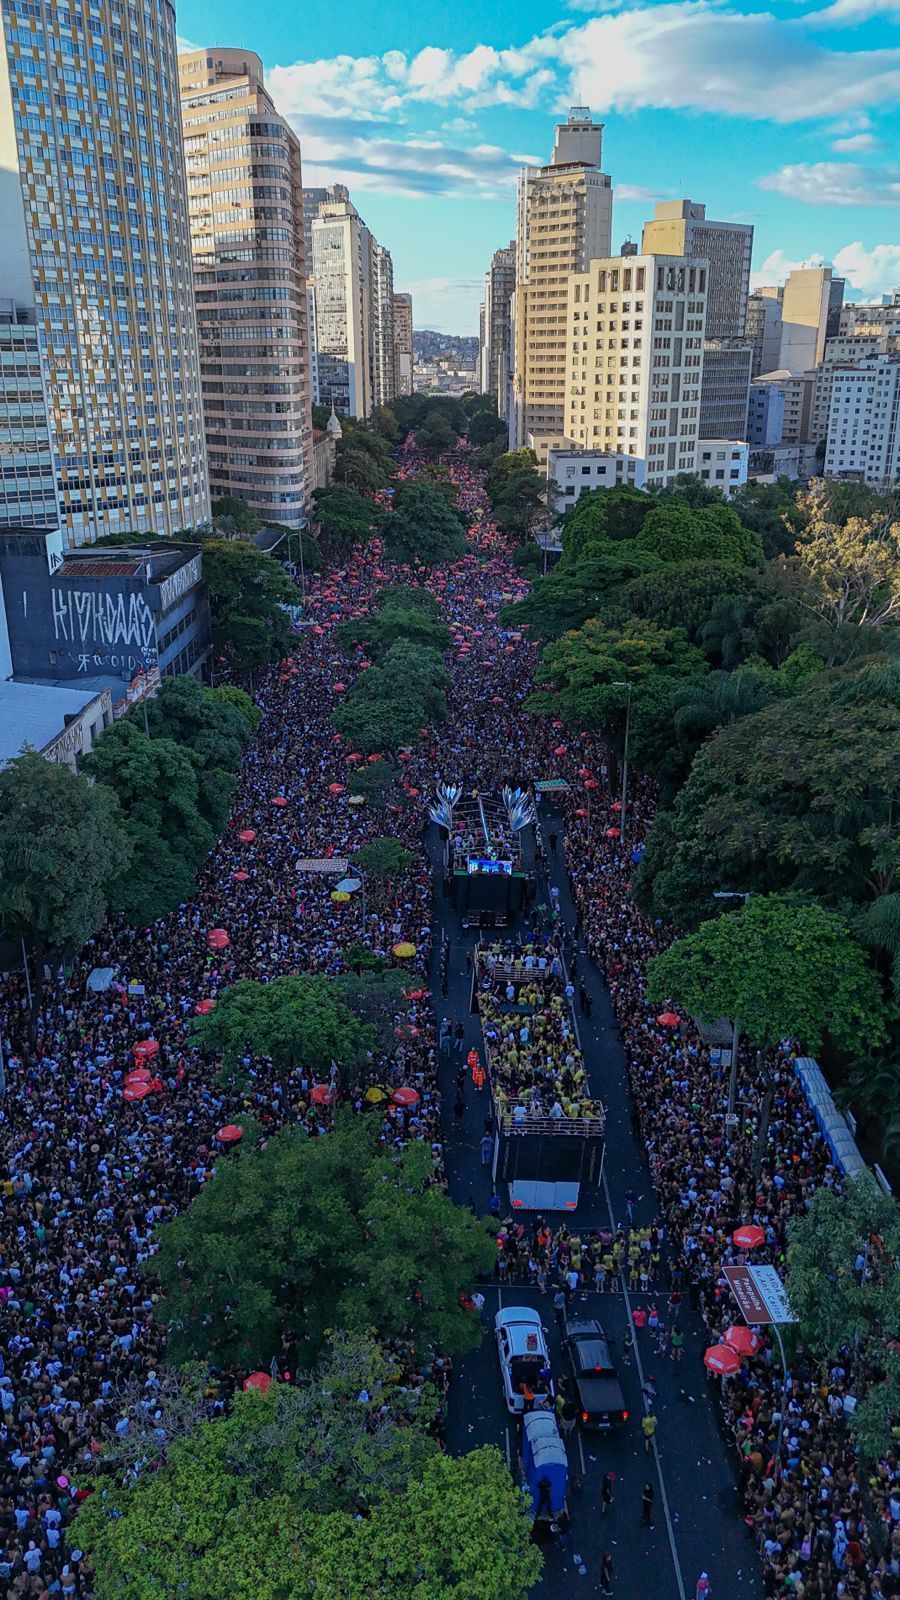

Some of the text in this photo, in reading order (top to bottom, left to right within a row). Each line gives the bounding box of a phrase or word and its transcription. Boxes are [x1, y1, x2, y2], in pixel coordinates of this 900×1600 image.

[732, 1279, 751, 1309] Mineirão
[742, 1277, 762, 1311] Pampulha
[767, 1295, 783, 1319] Carlos
